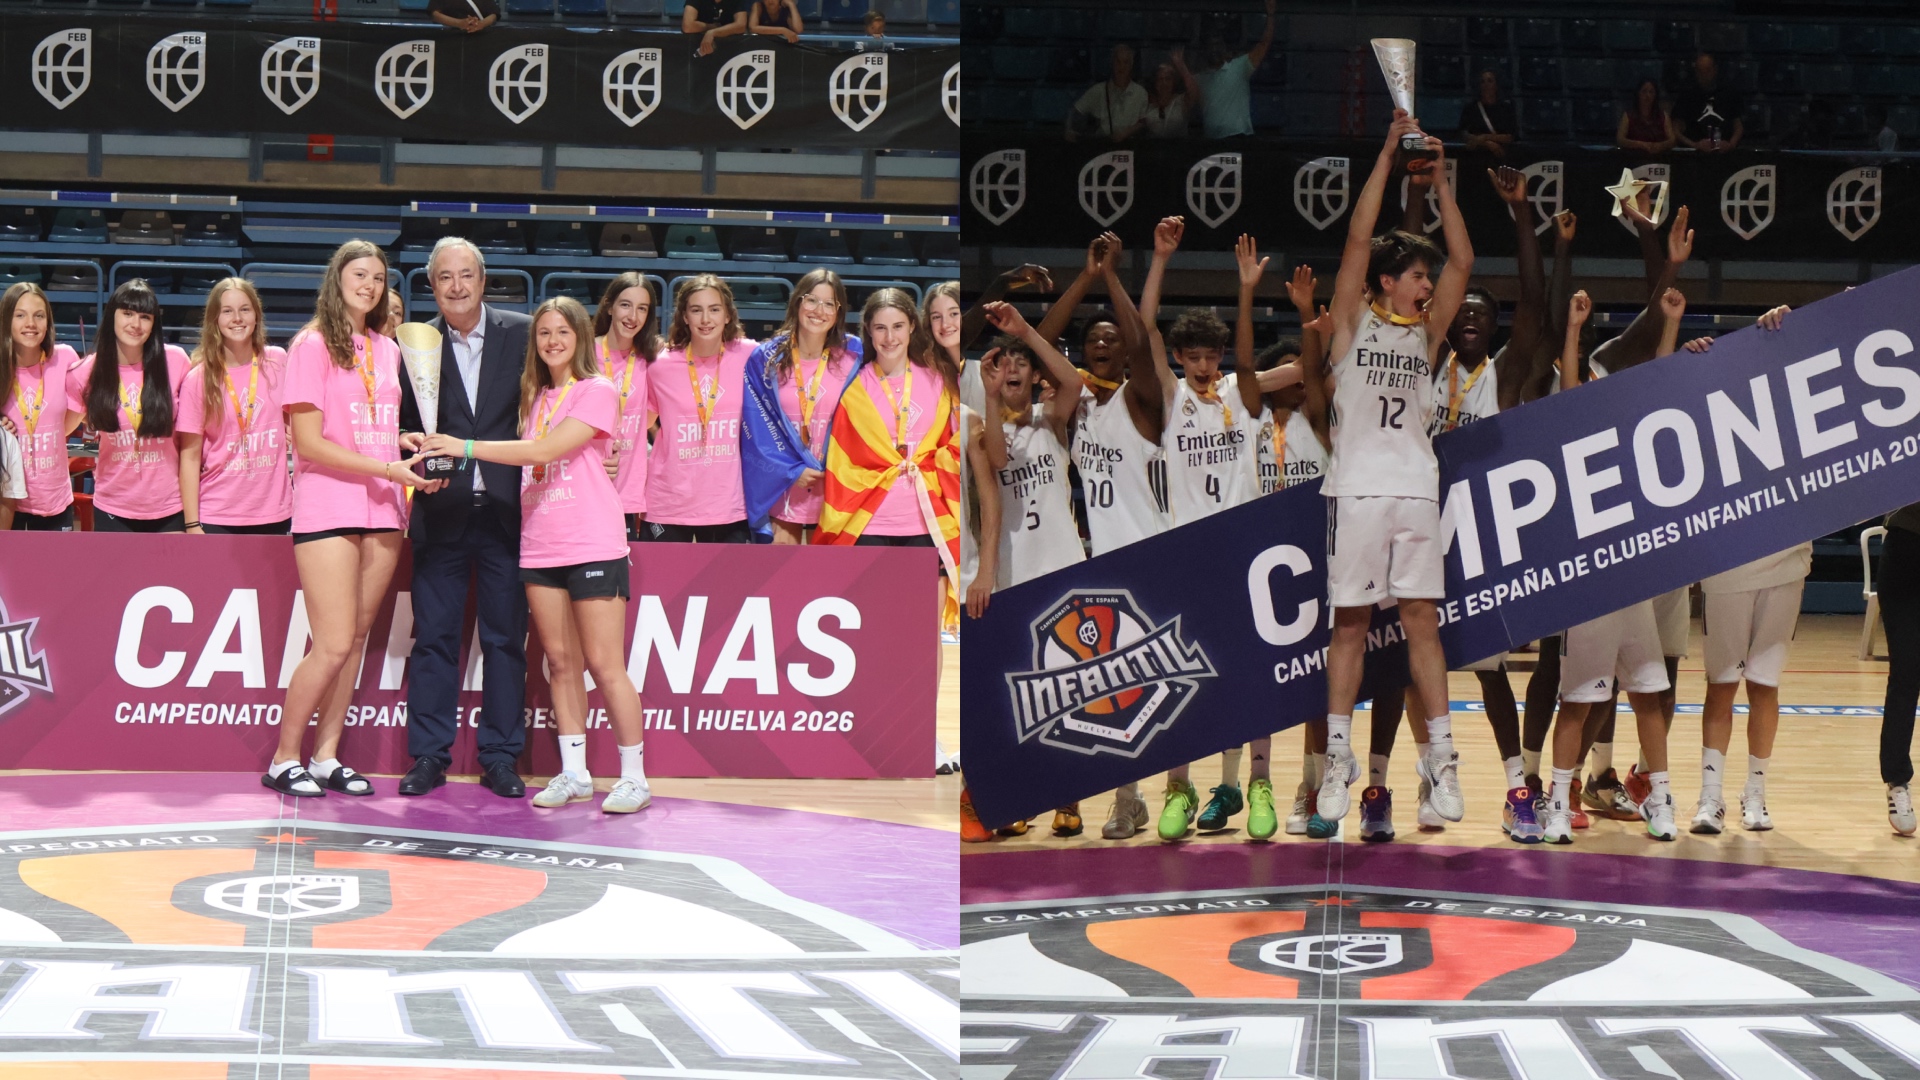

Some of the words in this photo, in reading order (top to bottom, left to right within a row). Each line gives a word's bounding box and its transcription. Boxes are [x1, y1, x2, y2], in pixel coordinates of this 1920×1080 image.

[68, 33, 87, 42] FEB
[182, 35, 202, 45] FEB
[297, 39, 316, 49] FEB
[411, 44, 430, 53] FEB
[525, 47, 544, 57] FEB
[638, 52, 657, 61] FEB
[752, 54, 771, 64] FEB
[864, 56, 883, 66] FEB
[1003, 153, 1021, 162] FEB
[1111, 154, 1129, 163] FEB
[1219, 156, 1238, 165] FEB
[1327, 158, 1345, 168] FEB
[1541, 164, 1559, 173] FEB
[1648, 167, 1666, 176] FEB
[1754, 168, 1772, 178] FEB
[1860, 169, 1878, 179] FEB
[1356, 348, 1430, 377] Emirates
[1366, 369, 1386, 386] FLY
[1388, 372, 1418, 391] BETTE
[1378, 395, 1406, 430] 12
[766, 420, 781, 441] Mini
[775, 441, 786, 452] A2
[1188, 453, 1203, 468] FLY
[1258, 460, 1320, 477] mrates
[521, 459, 573, 487] SATFE
[1013, 482, 1029, 500] FLY
[1088, 478, 1114, 508] 10
[1205, 474, 1221, 503] 4
[1247, 329, 1920, 646] CMPEONES
[1465, 567, 1556, 618] ESPAÑA
[1558, 553, 1590, 583] DE
[1594, 522, 1681, 570] CLUBES
[1685, 486, 1786, 537] INFANTIL
[1801, 448, 1887, 495] HUELVA
[1040, 604, 1071, 631] CAMPEONATO
[1017, 627, 1203, 730] INFANTIL
[114, 702, 282, 726] CAMPEONATO
[344, 701, 409, 727] SPAÑ
[696, 709, 787, 732] HUELVA
[791, 710, 855, 732] 2026
[1077, 723, 1112, 735] HUELVA
[1138, 700, 1157, 723] 2026
[362, 839, 425, 851] DE
[447, 846, 625, 872] ESPAÑA
[982, 899, 1271, 924] CAMPEONATO
[1404, 900, 1461, 911] DE
[1482, 906, 1648, 927] ESPAÑA
